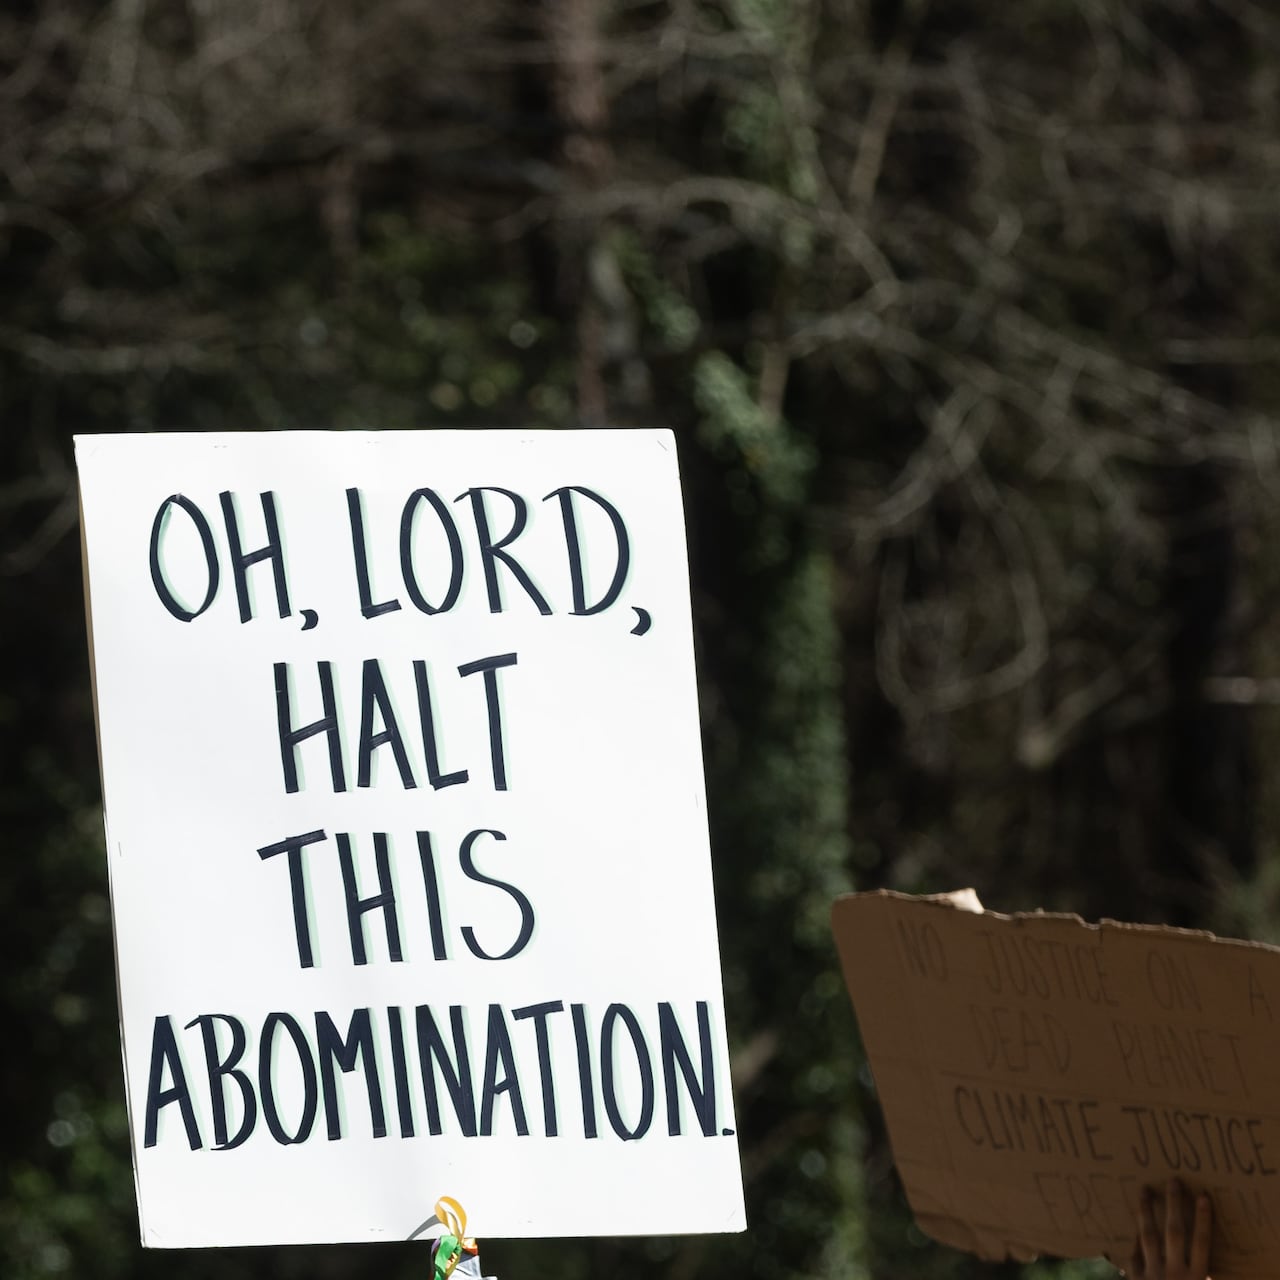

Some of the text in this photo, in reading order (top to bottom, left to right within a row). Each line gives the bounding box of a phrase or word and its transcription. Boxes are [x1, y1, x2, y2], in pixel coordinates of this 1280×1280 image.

[148, 486, 653, 636] OH, LORD,
[274, 652, 518, 793] HALT
[257, 828, 535, 968] THIS
[897, 917, 1275, 1023] NO JUSTICE ON A
[144, 1000, 736, 1150] ABOMINATION.
[969, 1003, 1252, 1100] DEAD PLANET
[952, 1083, 1114, 1162] CLIMATE
[1120, 1104, 1277, 1177] JUSTICE
